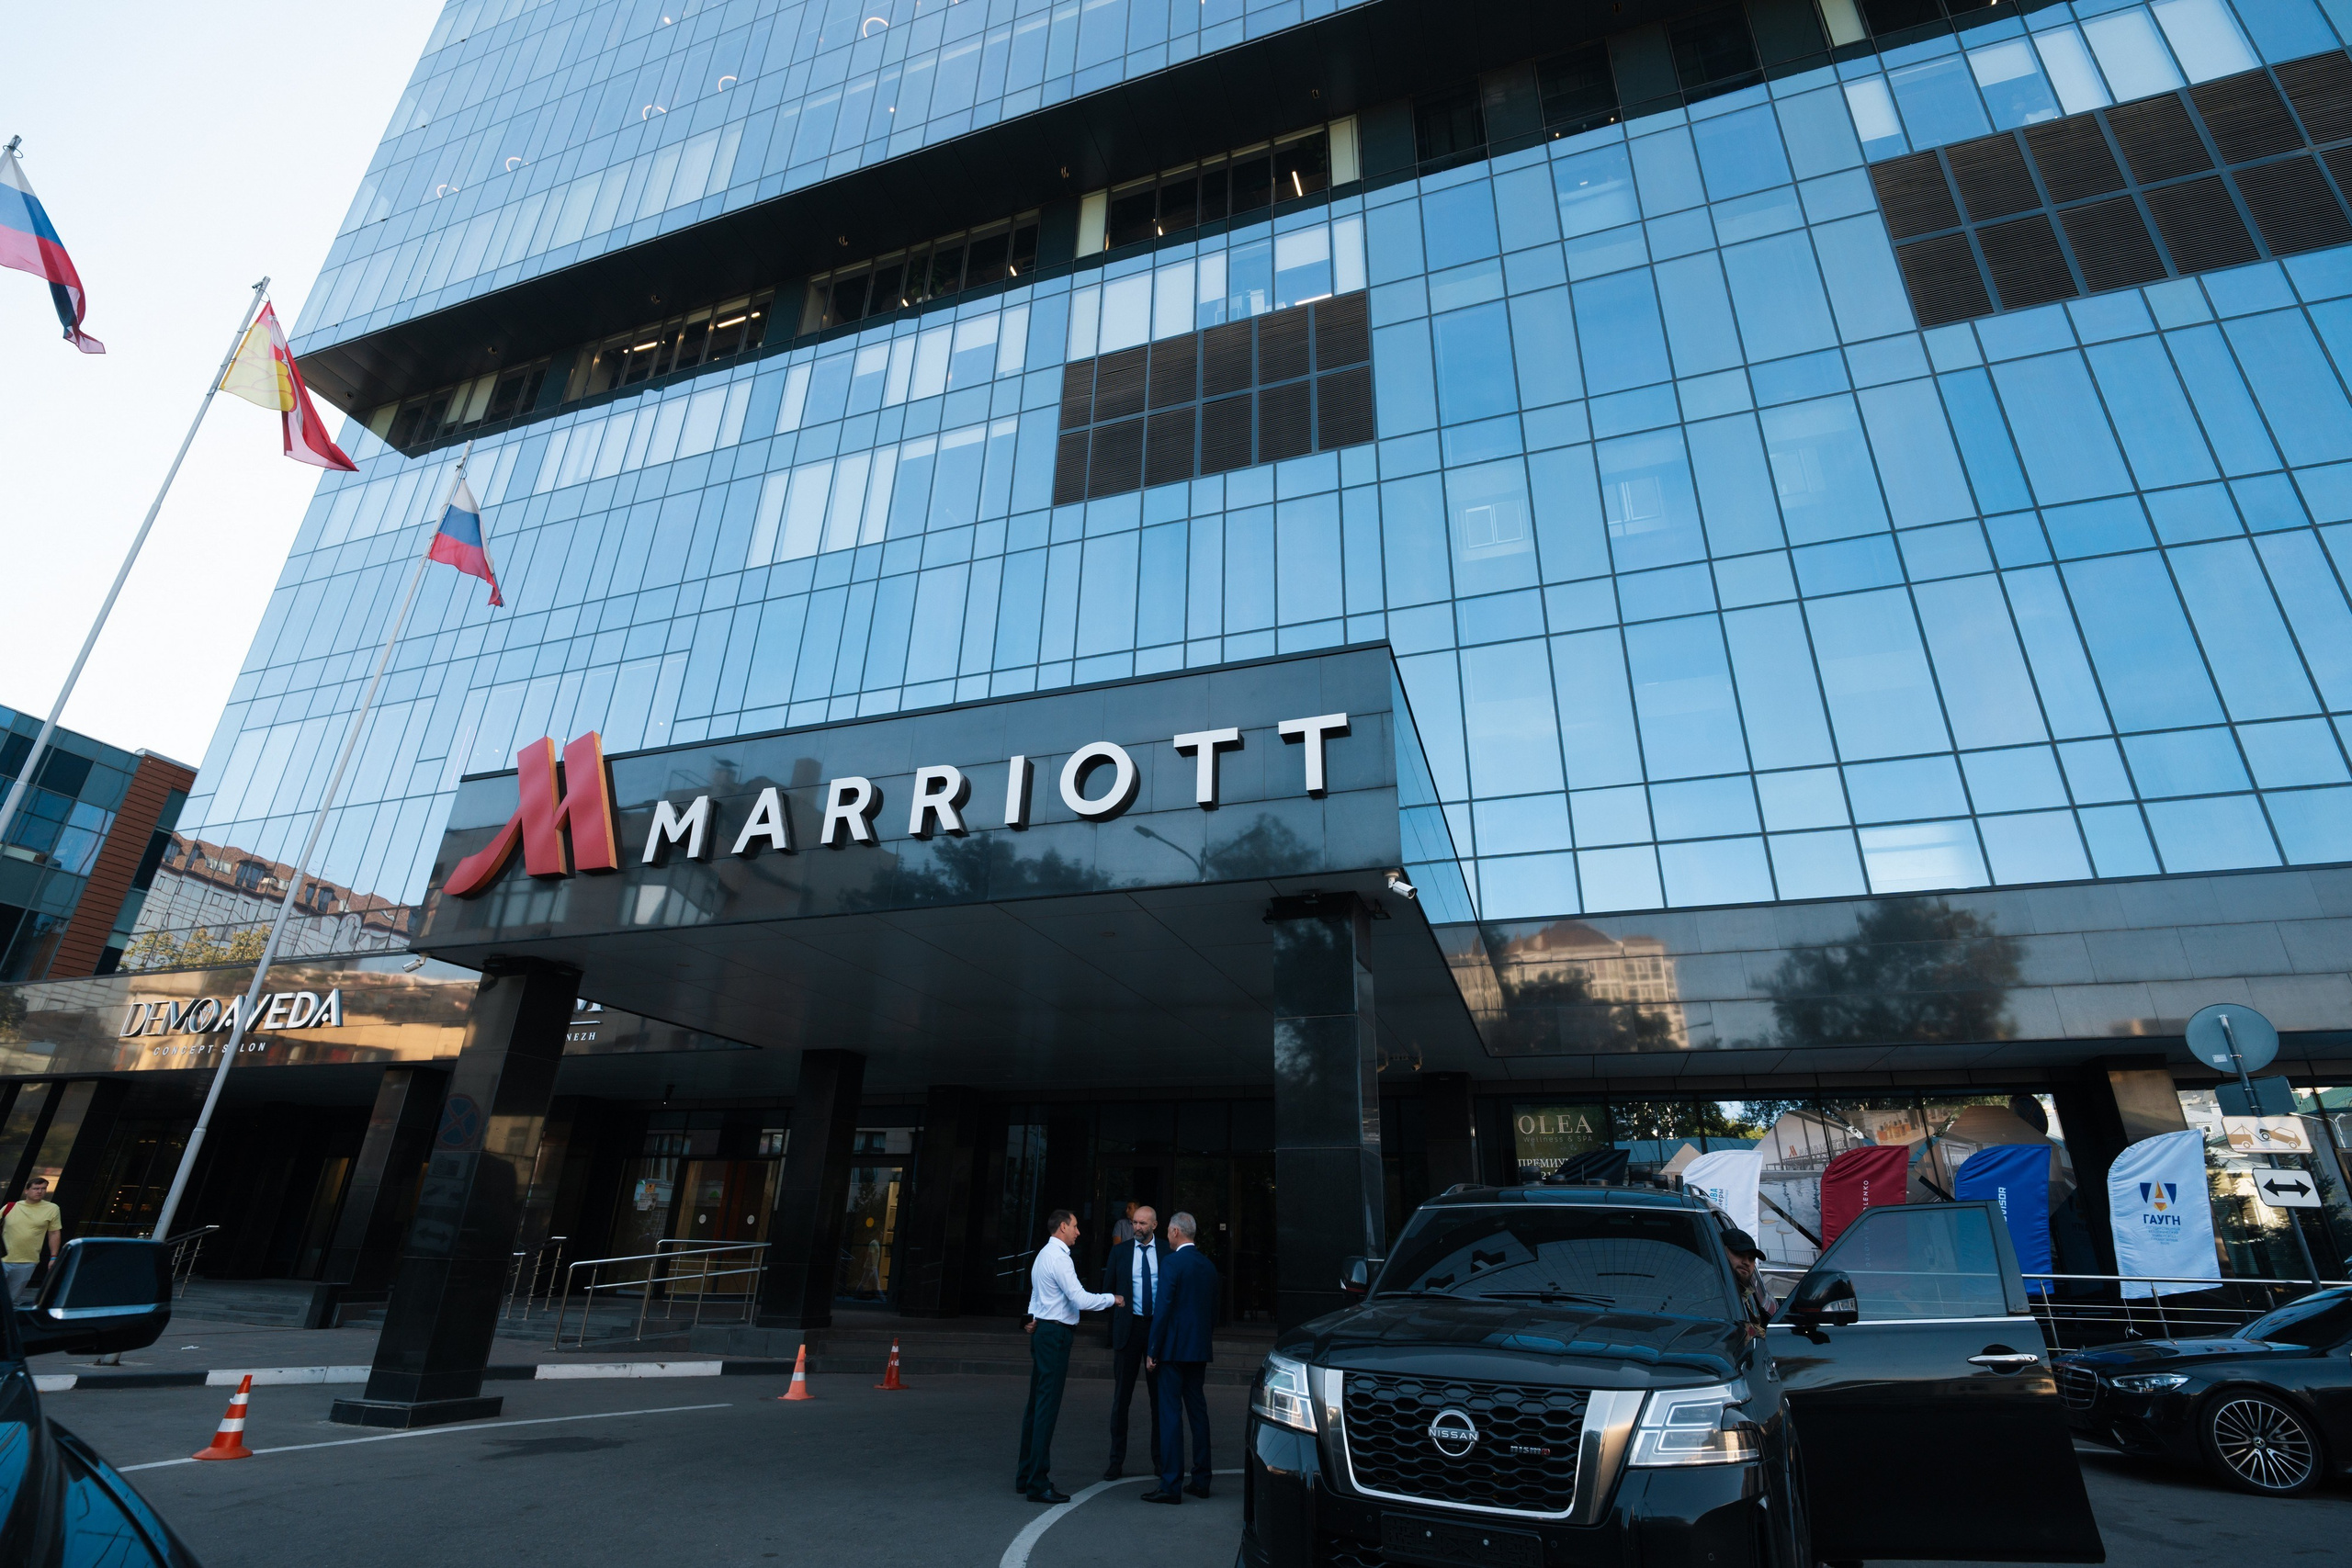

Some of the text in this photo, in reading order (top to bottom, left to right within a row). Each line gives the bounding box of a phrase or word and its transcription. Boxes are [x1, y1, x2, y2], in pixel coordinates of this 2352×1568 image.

[640, 712, 1351, 866] MARRIOTT
[153, 1042, 266, 1055] CONCEPT SLON
[1518, 1114, 1593, 1134] OLEA
[1518, 1158, 1568, 1168] ПРЕМИУ
[2143, 1213, 2181, 1226] ГАУГН
[1428, 1428, 1477, 1440] NISSAN
